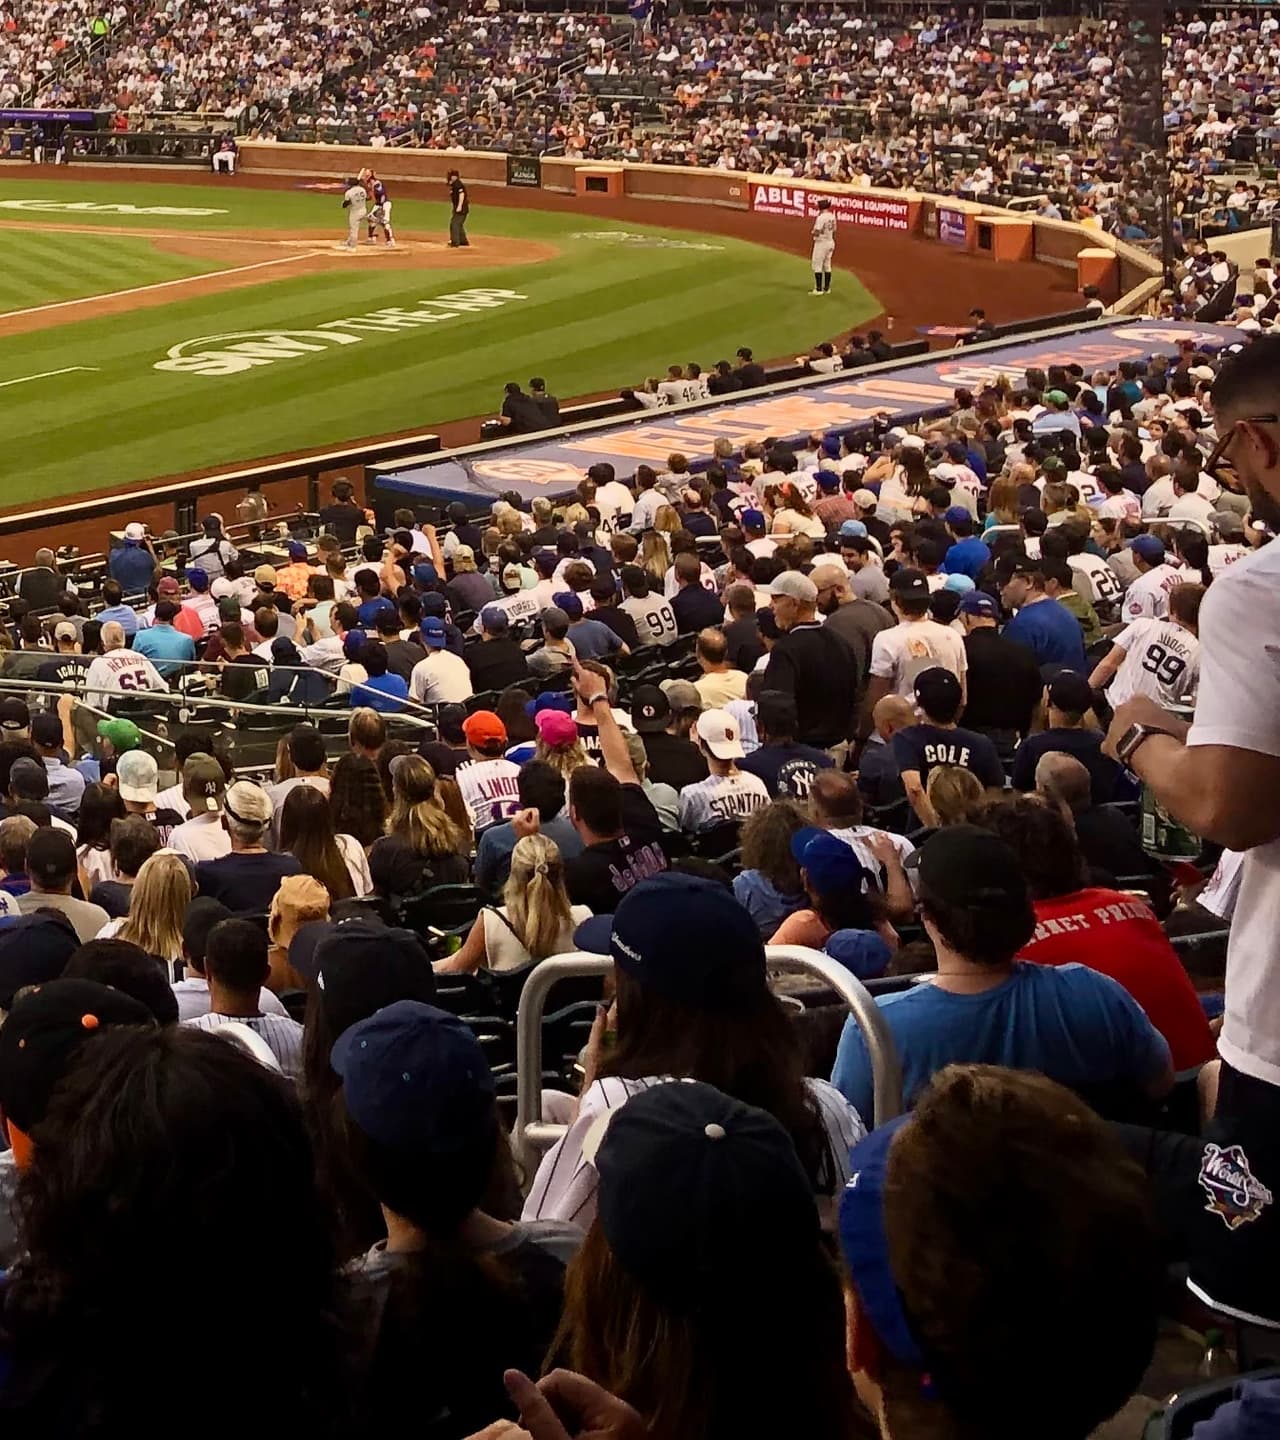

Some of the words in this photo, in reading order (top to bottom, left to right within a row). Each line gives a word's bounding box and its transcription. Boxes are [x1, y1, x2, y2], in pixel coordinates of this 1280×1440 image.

[754, 186, 805, 210] ABLE
[864, 199, 908, 215] EQUIPMENT
[836, 211, 854, 223] Sales
[859, 214, 884, 227] Service
[889, 217, 908, 230] Parts
[153, 334, 328, 376] SNY
[318, 301, 460, 332] THE
[436, 287, 529, 313] APP
[682, 385, 695, 401] 46
[559, 396, 902, 460] WELCOME
[823, 378, 956, 404] TO
[646, 605, 677, 637] 99
[1157, 631, 1191, 658] JUDGE
[1143, 643, 1186, 686] 99
[118, 670, 150, 690] 65
[924, 744, 970, 766] COLE
